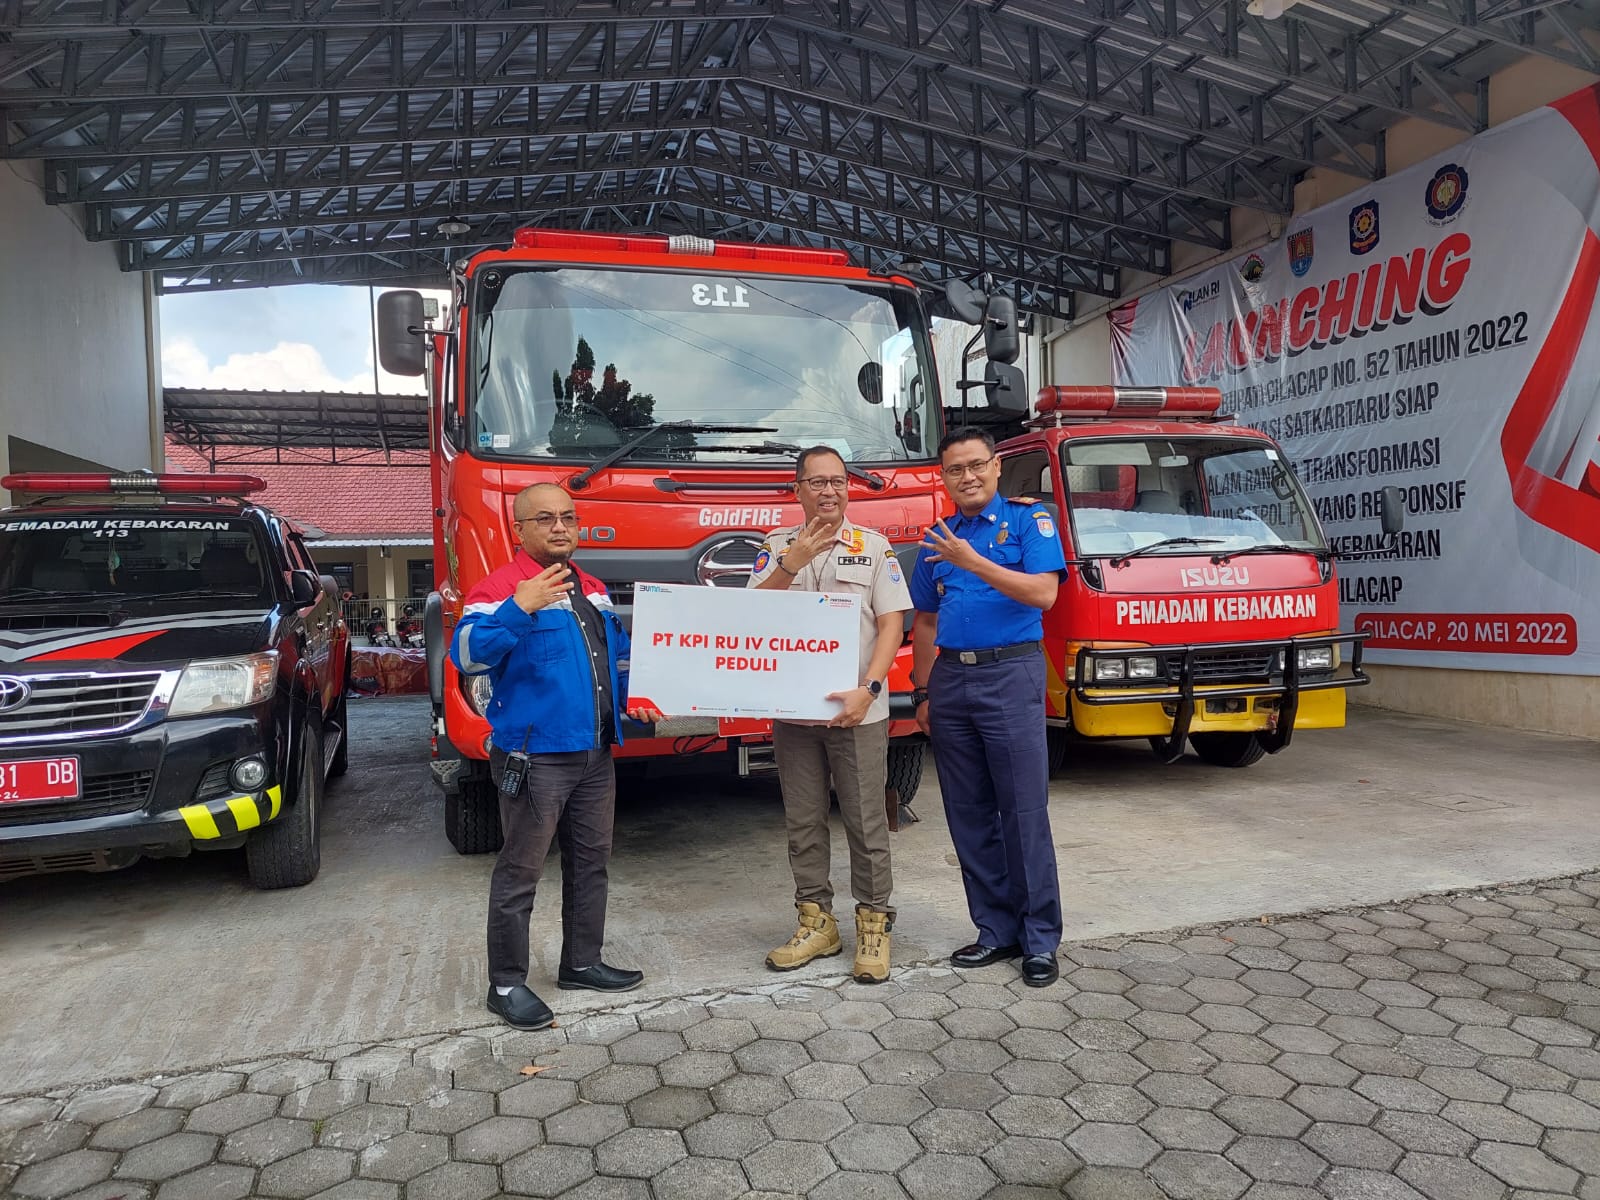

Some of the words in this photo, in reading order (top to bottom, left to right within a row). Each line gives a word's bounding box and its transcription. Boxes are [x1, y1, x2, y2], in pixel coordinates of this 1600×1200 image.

[1192, 285, 1210, 303] LAN
[1211, 279, 1220, 296] RI
[1181, 232, 1472, 383] LAUNCHING
[1266, 365, 1329, 404] CILACAP
[1333, 357, 1361, 388] NO.
[1366, 349, 1390, 379] 52
[1394, 328, 1460, 372] TAHUN
[1467, 311, 1529, 355] 2022
[1285, 392, 1390, 439] SATKARTARU
[1395, 381, 1440, 417] SIAP
[1208, 470, 1242, 497] ALAM
[1303, 437, 1441, 483] TRANSFORMASI
[1313, 493, 1356, 522] YANG
[1361, 479, 1467, 518] REPONSIF
[103, 520, 230, 531] KEBAKARAN
[698, 507, 783, 527] GoldFIRE
[93, 529, 129, 538] 113
[1330, 529, 1441, 561] KEBAKARAN
[1180, 566, 1250, 588] ISUZU
[1338, 576, 1403, 603] ILACAP
[1116, 599, 1208, 625] PEMADAM
[1214, 594, 1316, 622] KEBAKARAN
[652, 632, 674, 647] PT
[679, 633, 709, 649] KPI
[715, 635, 739, 650] RU
[744, 636, 764, 651] IV
[768, 637, 840, 653] CILACAP
[1446, 621, 1468, 642] 20
[1474, 622, 1510, 643] MEI
[1515, 622, 1568, 644] 2022
[715, 656, 777, 672] PEDULI
[46, 761, 75, 785] DB
